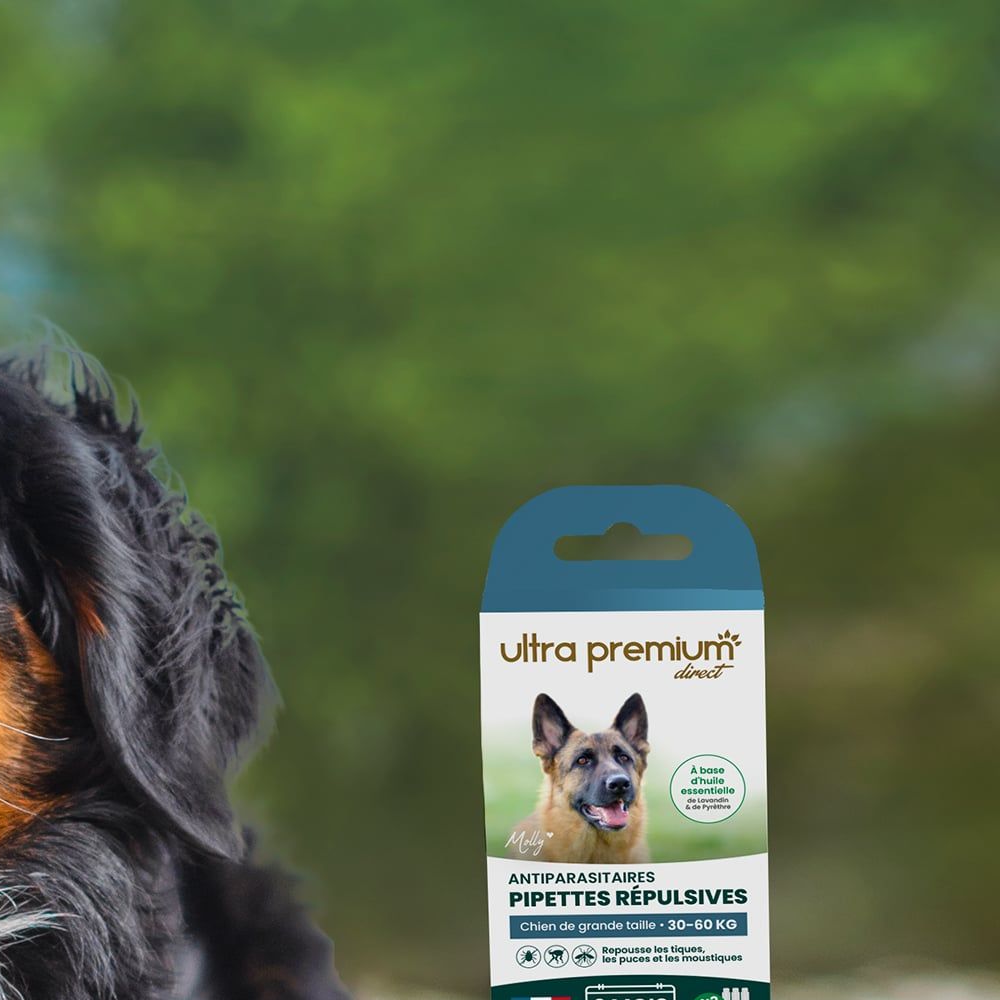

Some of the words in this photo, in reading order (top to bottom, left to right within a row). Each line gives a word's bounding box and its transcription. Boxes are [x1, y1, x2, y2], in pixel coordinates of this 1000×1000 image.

[500, 633, 577, 663] ultra
[587, 636, 734, 673] premium
[674, 663, 734, 679] direct
[690, 765, 697, 774] À
[700, 766, 725, 774] base
[691, 777, 725, 785] d'huile
[681, 786, 735, 795] essentielle
[504, 830, 545, 856] Molly
[508, 871, 655, 885] ANTIPARASITAIRES
[509, 890, 611, 907] PIPETTES
[615, 885, 748, 906] RÉPULSIVES
[520, 921, 557, 932] Chien
[559, 921, 575, 931] de
[578, 921, 623, 934] grande
[626, 920, 656, 931] taille
[667, 919, 713, 931] 30-60
[715, 919, 738, 930] KG
[602, 946, 652, 956] Repousse
[654, 945, 668, 953] les
[671, 945, 706, 955] tiques,
[602, 955, 616, 963] les
[619, 956, 650, 965] puces
[665, 954, 679, 962] les
[682, 953, 743, 963] moustiques
